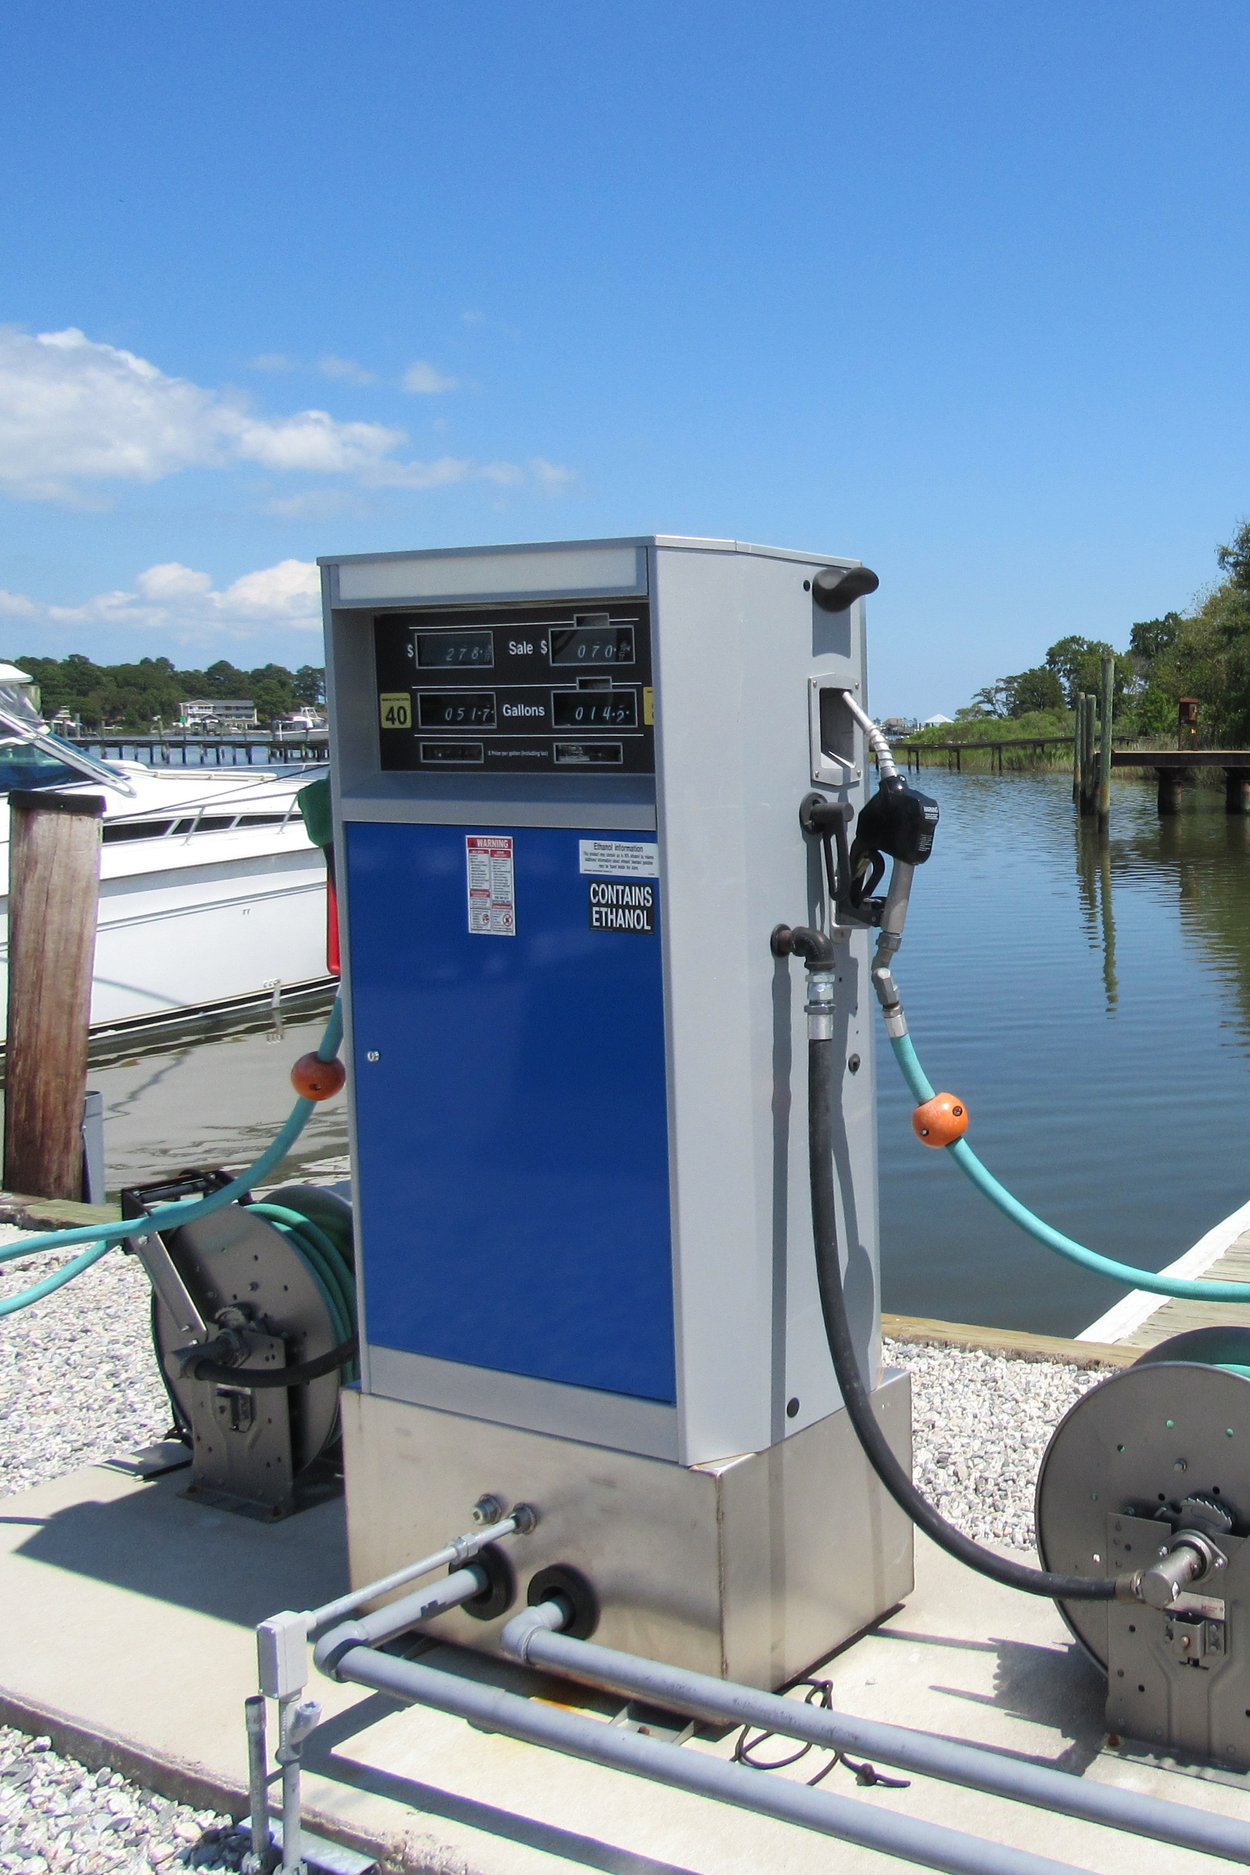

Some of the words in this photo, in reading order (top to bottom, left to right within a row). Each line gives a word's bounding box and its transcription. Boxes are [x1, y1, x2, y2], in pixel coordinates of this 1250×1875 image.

[407, 643, 414, 658] $
[508, 641, 533, 656] Sale
[540, 640, 548, 656] $
[385, 705, 407, 726] 40
[502, 703, 545, 718] Gallons
[476, 838, 509, 848] WARNING
[594, 842, 613, 850] Ethanol
[590, 883, 653, 908] CONTAINS
[592, 907, 651, 930] ETHANOL
